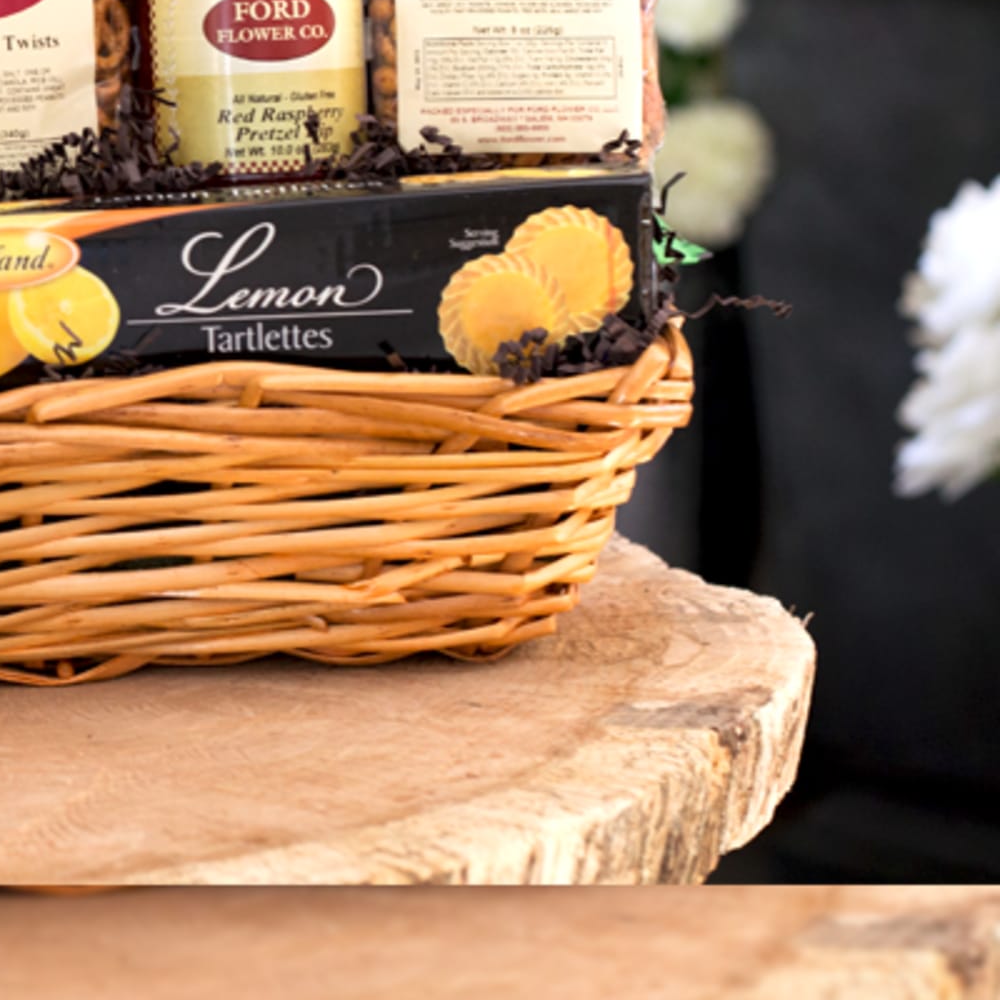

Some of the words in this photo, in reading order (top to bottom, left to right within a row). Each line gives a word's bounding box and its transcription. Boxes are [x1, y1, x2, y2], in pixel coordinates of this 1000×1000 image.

[232, 0, 312, 22] FORD
[3, 33, 61, 52] Twists
[215, 25, 297, 44] FLOWER
[299, 23, 330, 40] CO.
[217, 107, 256, 125] Red
[261, 106, 344, 126] Rasperry
[236, 123, 301, 143] Pretzel
[155, 221, 384, 317] Lemon
[201, 322, 334, 353] Tartlettes
